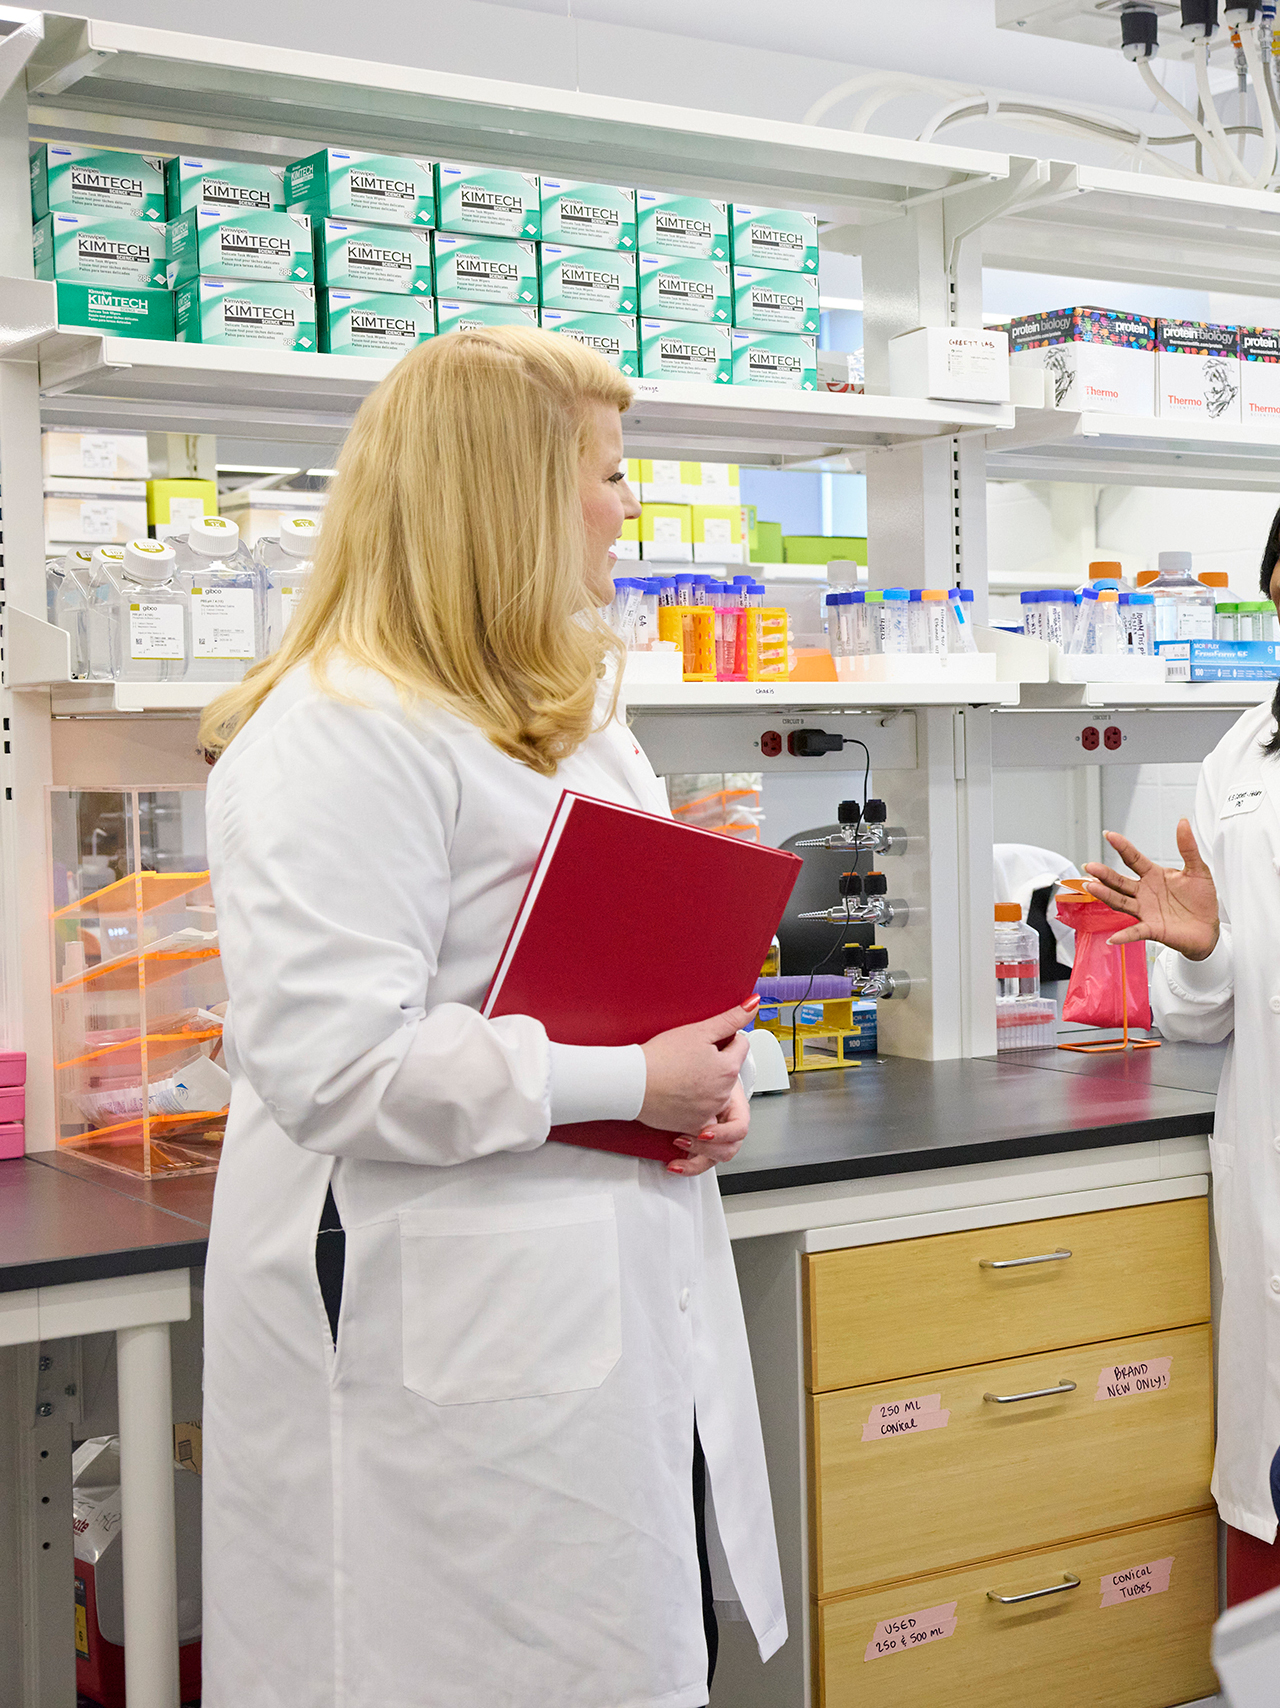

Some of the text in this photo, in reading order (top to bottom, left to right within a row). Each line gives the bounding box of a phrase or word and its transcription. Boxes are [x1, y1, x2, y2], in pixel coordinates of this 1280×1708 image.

[72, 172, 142, 191] KIMTECH
[351, 175, 414, 193] KIMTECH
[203, 185, 270, 202] KIMTECH
[462, 190, 522, 207] KIMTECH
[561, 203, 619, 220] KIMTECH
[656, 215, 711, 231] KIMTECH
[221, 233, 290, 249] KIMTECH
[752, 229, 804, 244] KIMTECH
[79, 239, 149, 256] KIMTECH
[348, 246, 412, 263] KIMTECH
[456, 259, 518, 274] KIMTECH
[562, 268, 620, 284] KIMTECH
[659, 278, 714, 293] KIMTECH
[88, 294, 148, 308] KIMTECH
[753, 292, 804, 305] KIMTECH
[224, 304, 294, 319] KIMTECH
[351, 315, 415, 330] KIMTECH
[1012, 317, 1071, 339] protein biology
[1115, 321, 1148, 335] protein
[1163, 326, 1234, 345] protein biology
[1244, 337, 1276, 348] protein
[661, 342, 716, 356] KIMTECH
[750, 352, 802, 366] KIMTECH
[1085, 386, 1119, 398] Thermo
[1168, 395, 1202, 407] Thermo
[1194, 668, 1204, 676] 100
[1113, 1364, 1149, 1380] BRAND
[1106, 1376, 1168, 1398] NEW ONLY!
[880, 1401, 922, 1418] 250 ML
[885, 1618, 917, 1635] USED
[875, 1640, 897, 1653] 250
[909, 1631, 928, 1644] 500
[930, 1627, 944, 1637] ML
